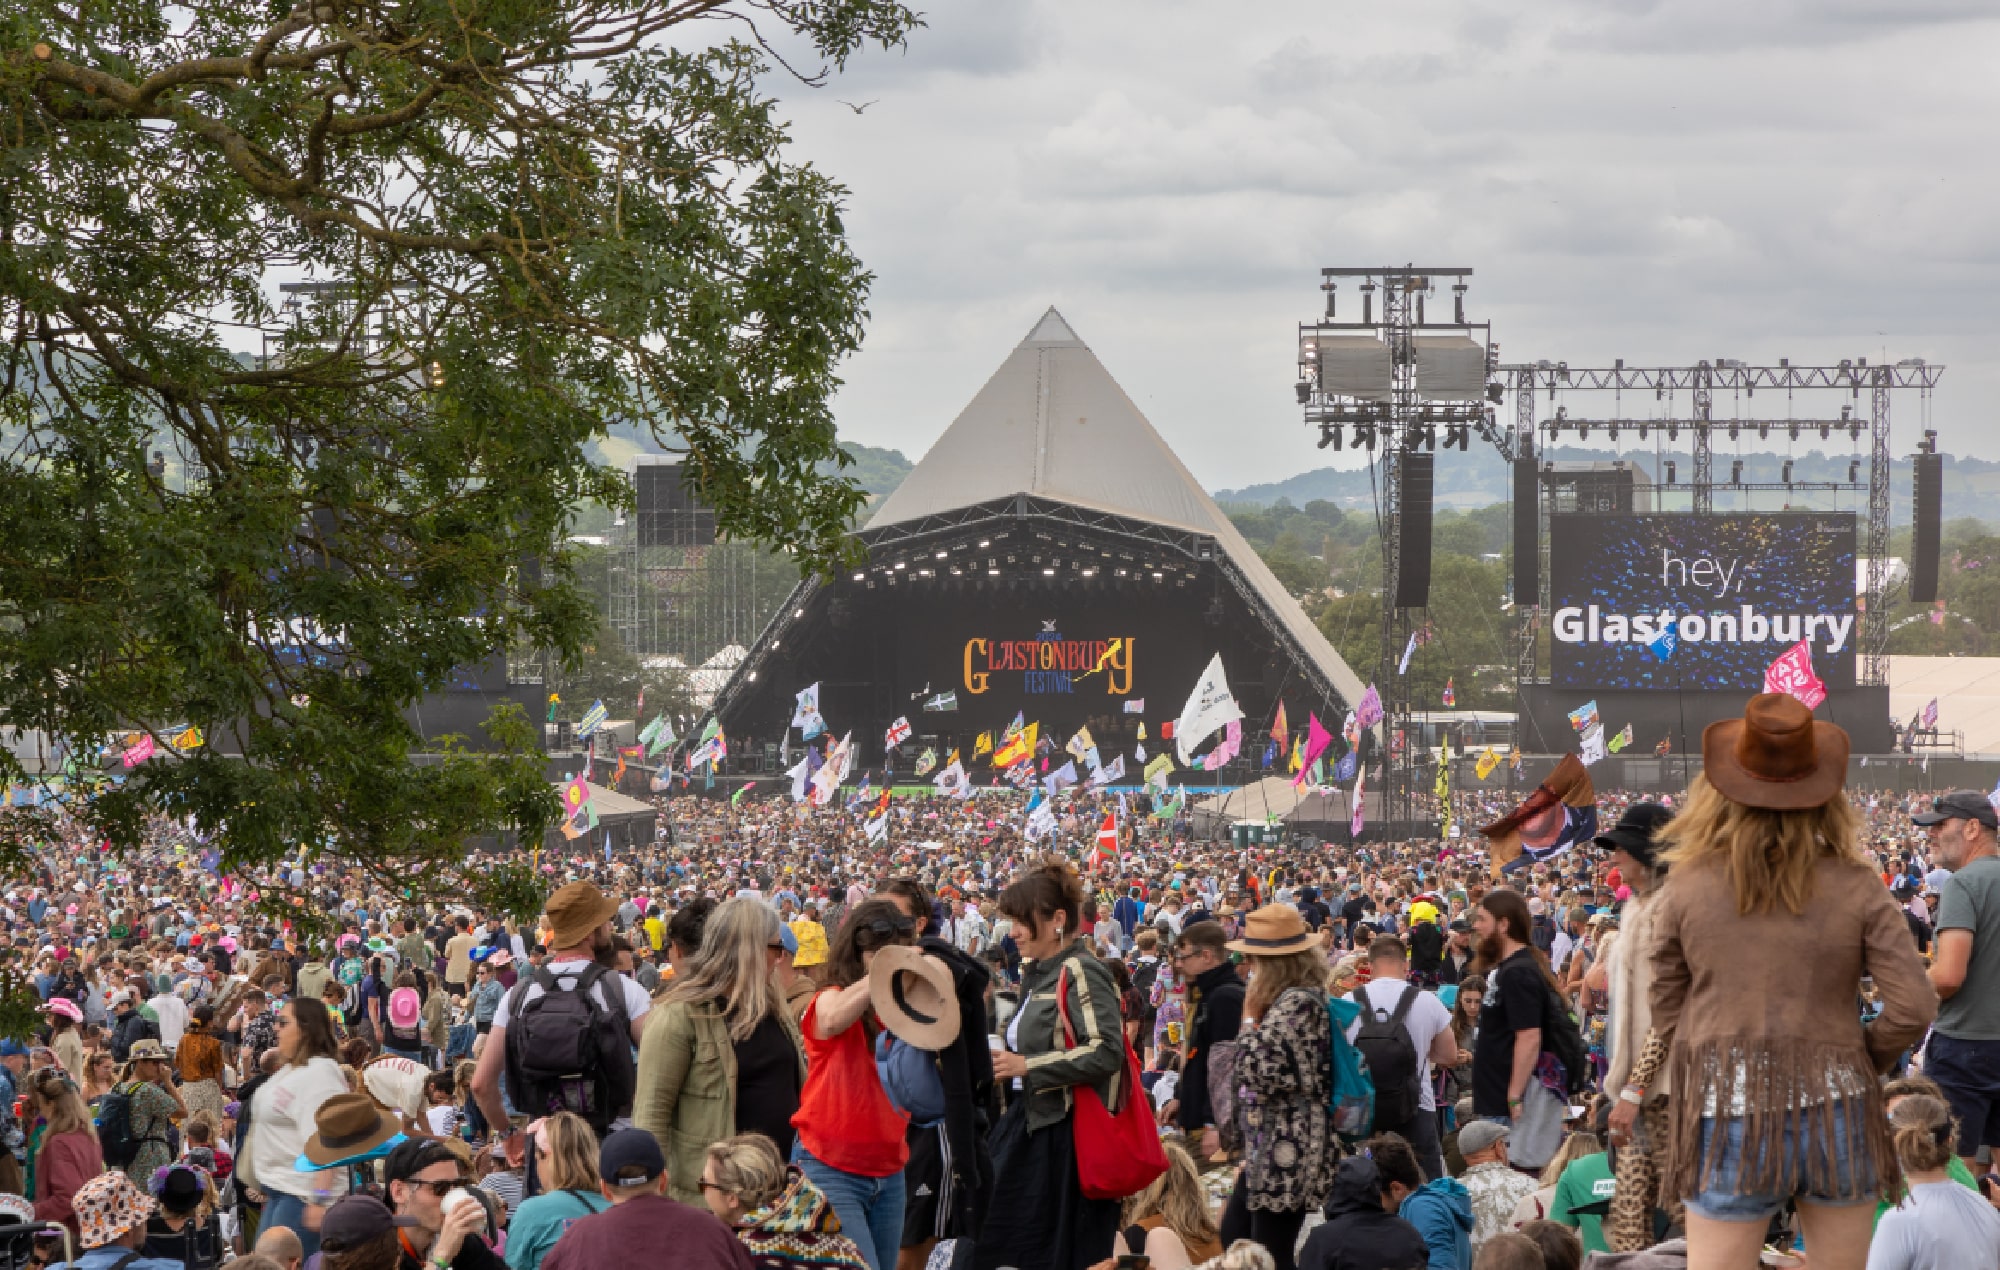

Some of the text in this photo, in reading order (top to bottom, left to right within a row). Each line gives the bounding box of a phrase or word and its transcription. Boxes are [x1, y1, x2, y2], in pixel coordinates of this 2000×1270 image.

[1662, 548, 1744, 598] hey,
[1553, 605, 1854, 654] Glastonbury
[1024, 671, 1074, 694] FESTIVAL
